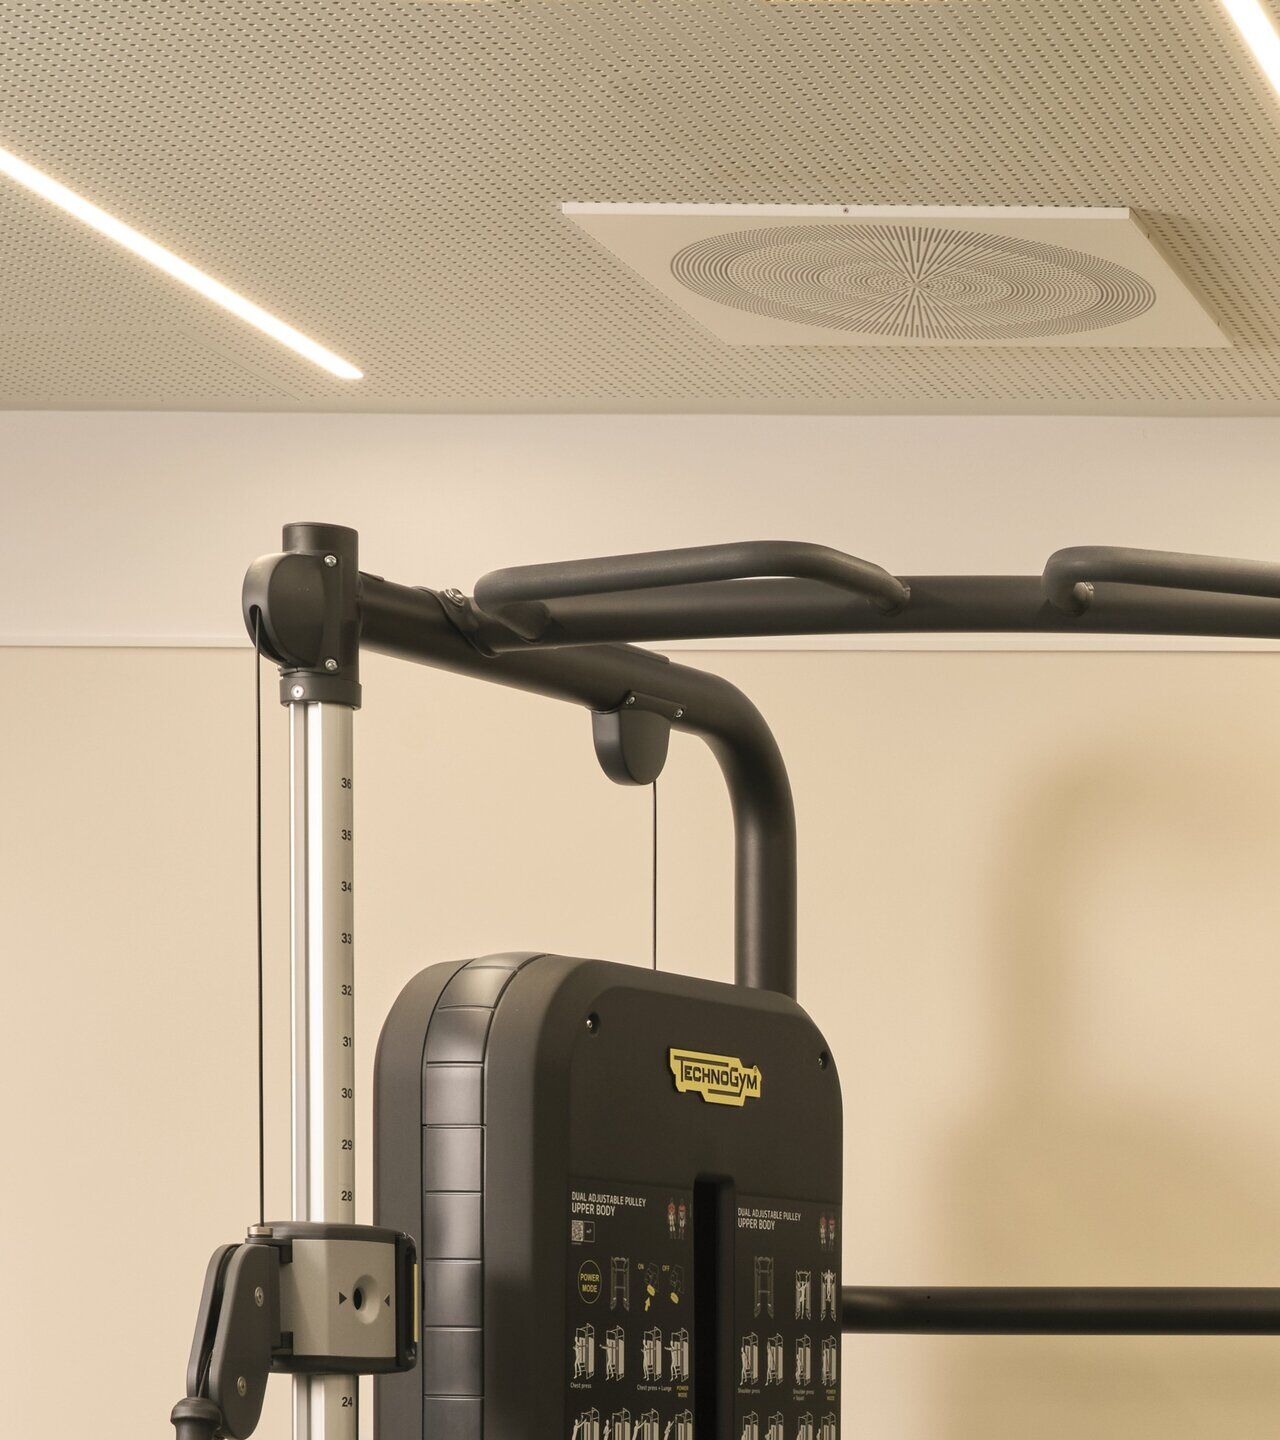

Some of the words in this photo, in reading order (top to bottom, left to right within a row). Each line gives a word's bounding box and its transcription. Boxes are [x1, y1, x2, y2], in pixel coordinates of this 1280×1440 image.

[341, 777, 352, 790] 36
[341, 828, 352, 842] 35
[341, 880, 352, 893] 34
[341, 932, 352, 945] 33
[341, 984, 352, 997] 32
[342, 1035, 352, 1048] 31
[341, 1087, 353, 1100] 30
[341, 1138, 353, 1151] 29
[341, 1190, 353, 1202] 28
[571, 1191, 587, 1201] DUAL
[588, 1192, 624, 1205] ADJUSTABLE
[625, 1196, 647, 1208] PULLEY
[571, 1202, 595, 1214] UPPER
[596, 1204, 616, 1216] BODY
[738, 1207, 751, 1217] DUAL
[752, 1209, 783, 1220] ADJUSTABLE
[783, 1211, 801, 1221] PULLEY
[738, 1217, 758, 1229] UPPER
[759, 1219, 776, 1231] BODY
[580, 1273, 600, 1282] POWER
[582, 1284, 598, 1293] MODE
[341, 1396, 353, 1408] 24
